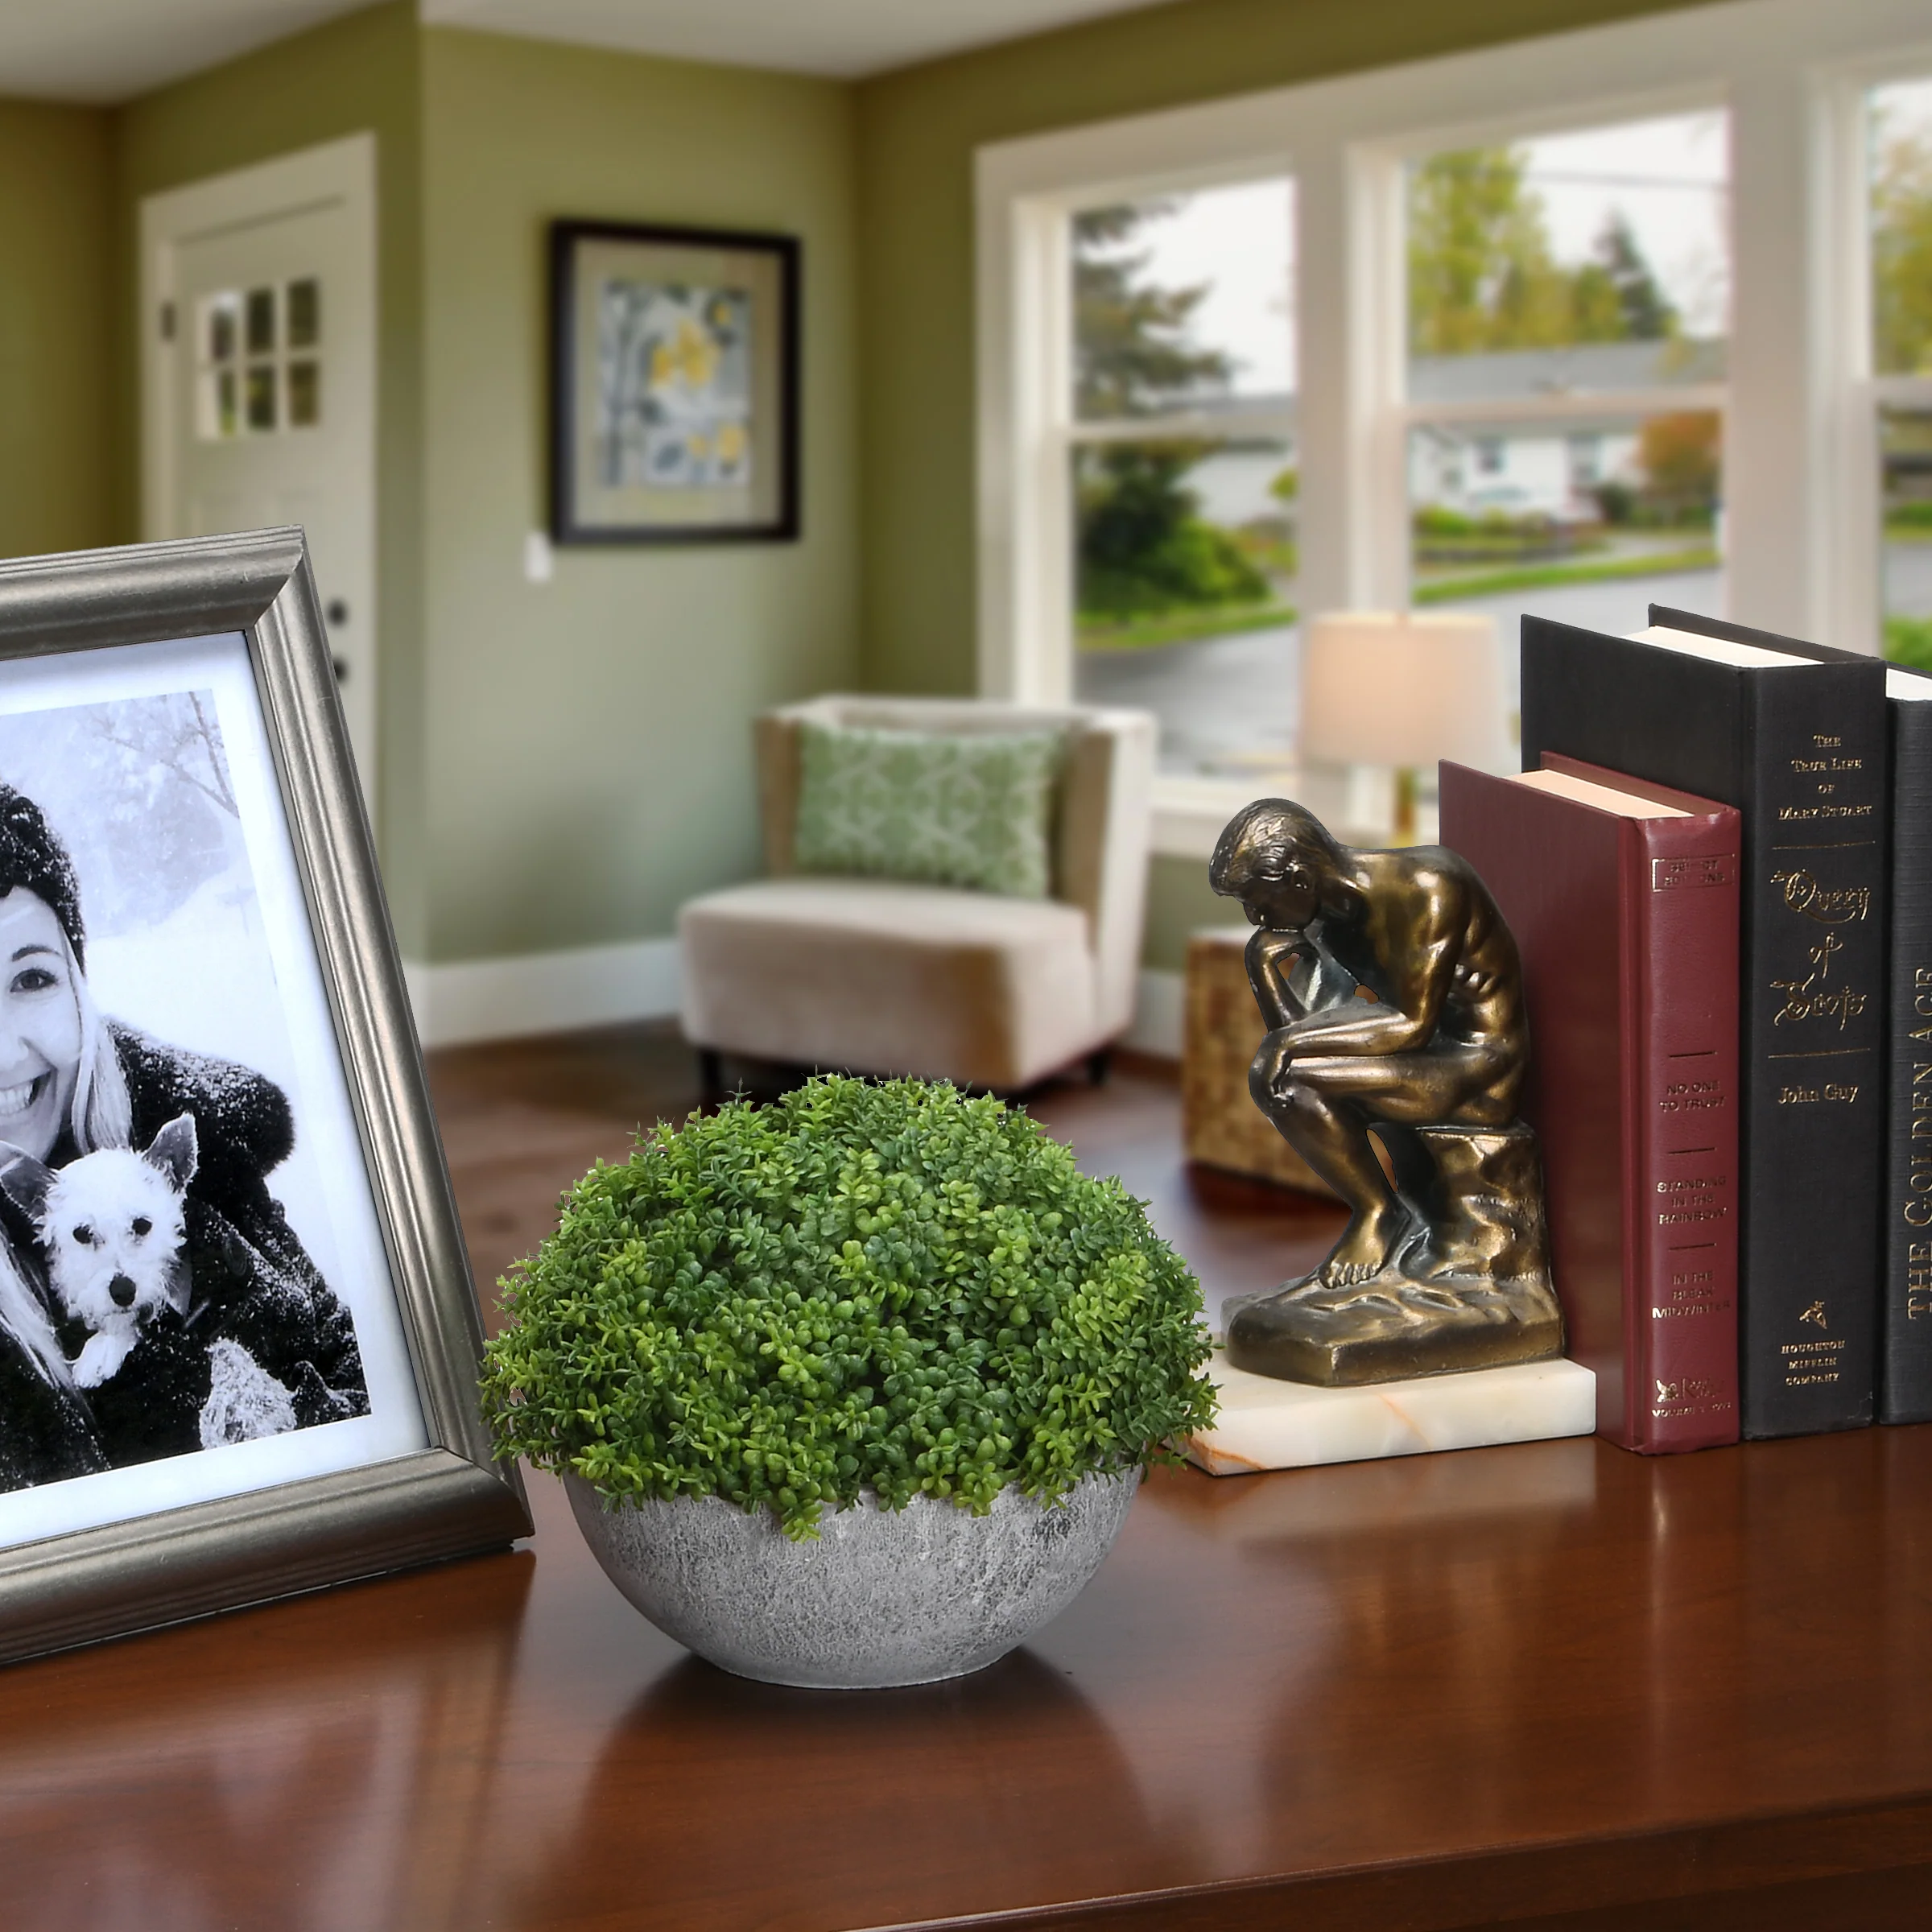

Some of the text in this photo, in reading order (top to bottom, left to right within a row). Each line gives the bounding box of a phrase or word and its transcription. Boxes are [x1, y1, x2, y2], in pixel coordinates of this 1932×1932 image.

[1813, 734, 1842, 748] THE
[1777, 805, 1872, 820] MARY STUART
[1809, 931, 1843, 979] of
[1667, 1084, 1689, 1096] NO
[1777, 1083, 1859, 1105] John Guy
[1659, 1101, 1679, 1113] TO
[1671, 1194, 1715, 1208] IN THE
[1671, 1270, 1713, 1285] IN THE
[1906, 1242, 1932, 1320] THE
[1781, 1340, 1846, 1354] HOUGHTON
[1788, 1357, 1838, 1370] MIFFLIN
[1785, 1373, 1839, 1385] COMPANY
